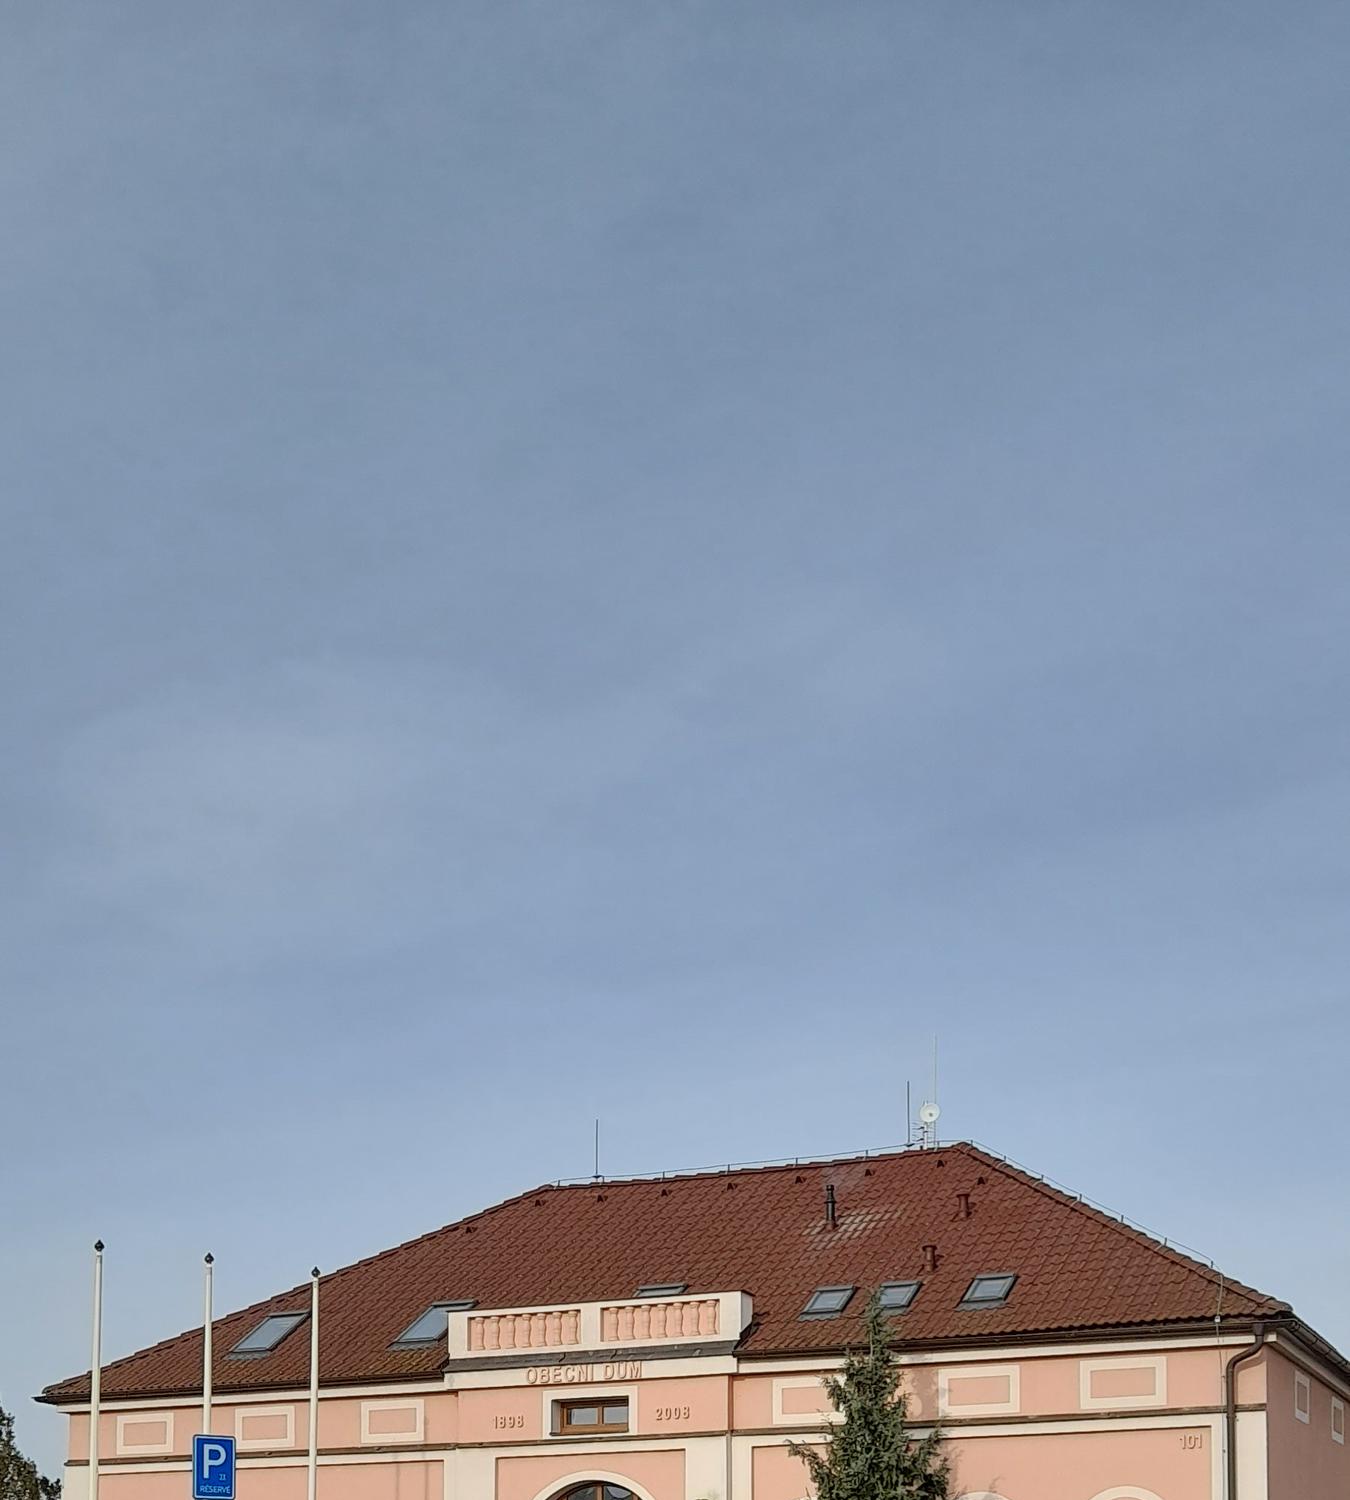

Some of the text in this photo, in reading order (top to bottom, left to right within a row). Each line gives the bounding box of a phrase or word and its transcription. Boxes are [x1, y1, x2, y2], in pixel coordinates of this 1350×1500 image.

[655, 1406, 690, 1421] 2008
[493, 1415, 525, 1429] 1898
[1179, 1433, 1203, 1450] 101
[203, 1443, 227, 1479] P
